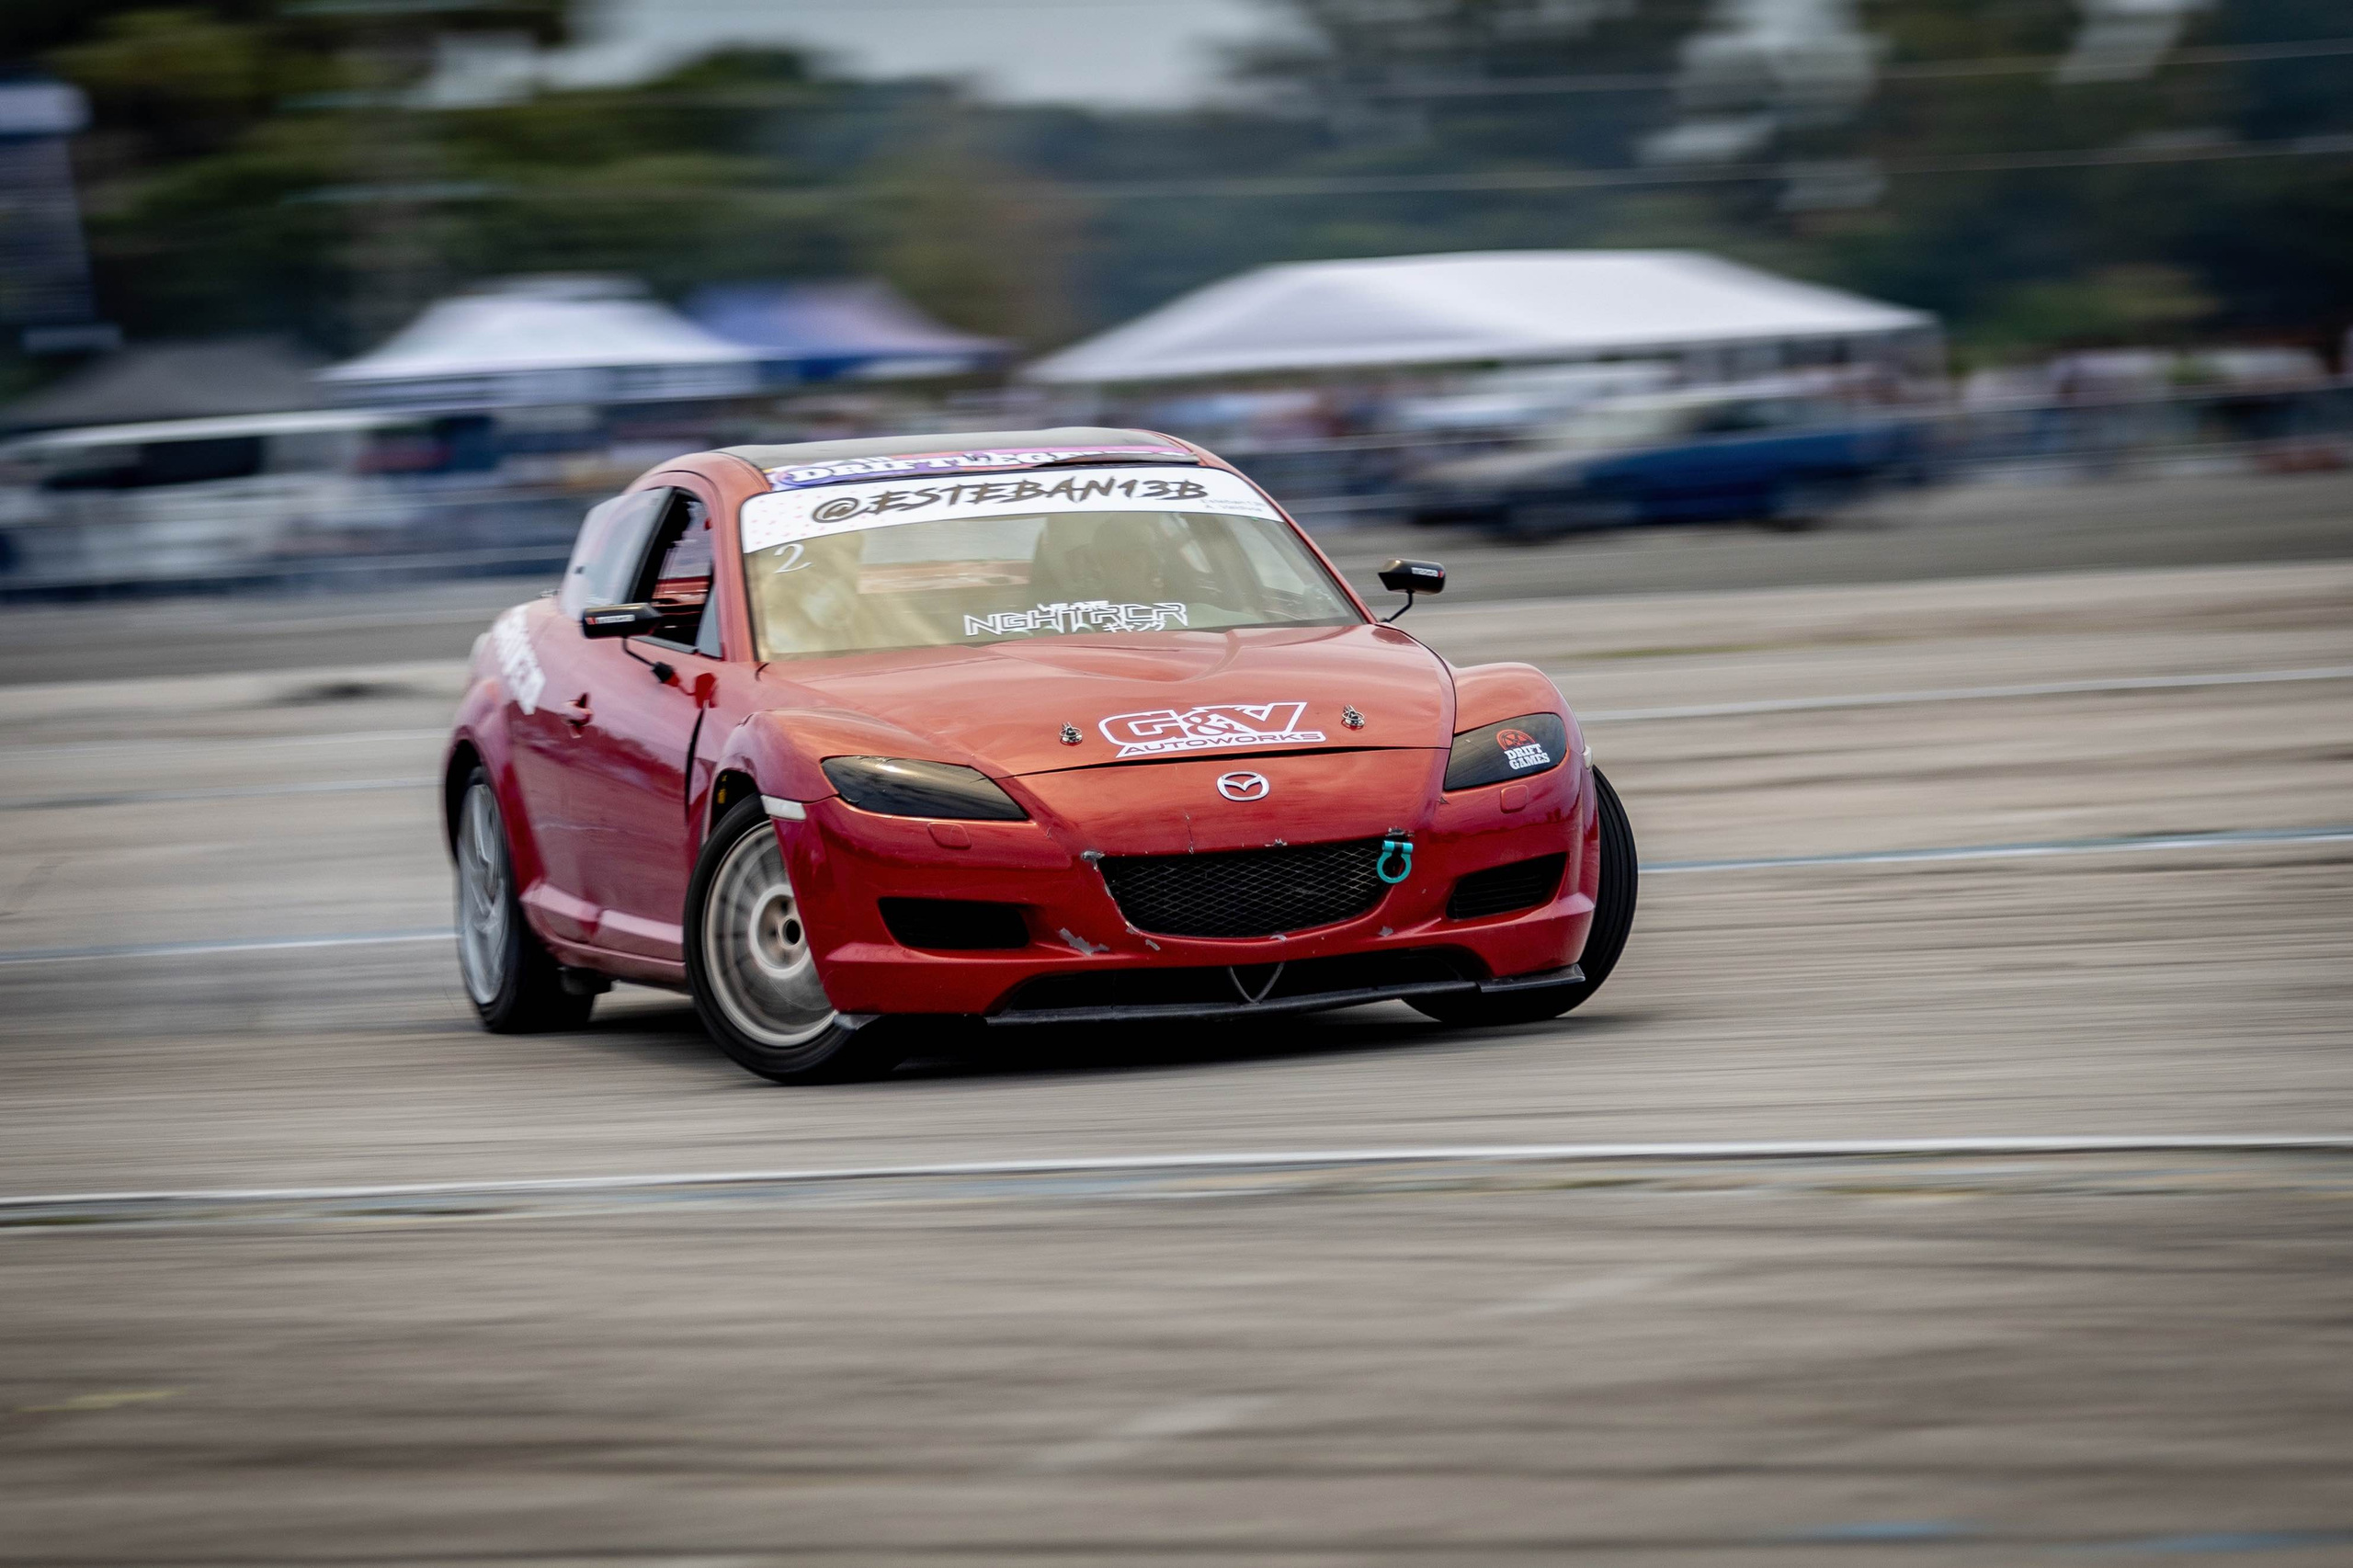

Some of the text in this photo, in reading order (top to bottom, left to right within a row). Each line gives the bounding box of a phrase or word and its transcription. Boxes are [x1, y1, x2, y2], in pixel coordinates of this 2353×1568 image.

[813, 476, 1209, 523] @ESTEBAN13B
[774, 543, 812, 574] 2
[1098, 702, 1308, 746] G&V
[1124, 733, 1321, 755] AUTOWORKS
[1504, 743, 1543, 760] DRIFT
[1508, 752, 1551, 770] GAMES
